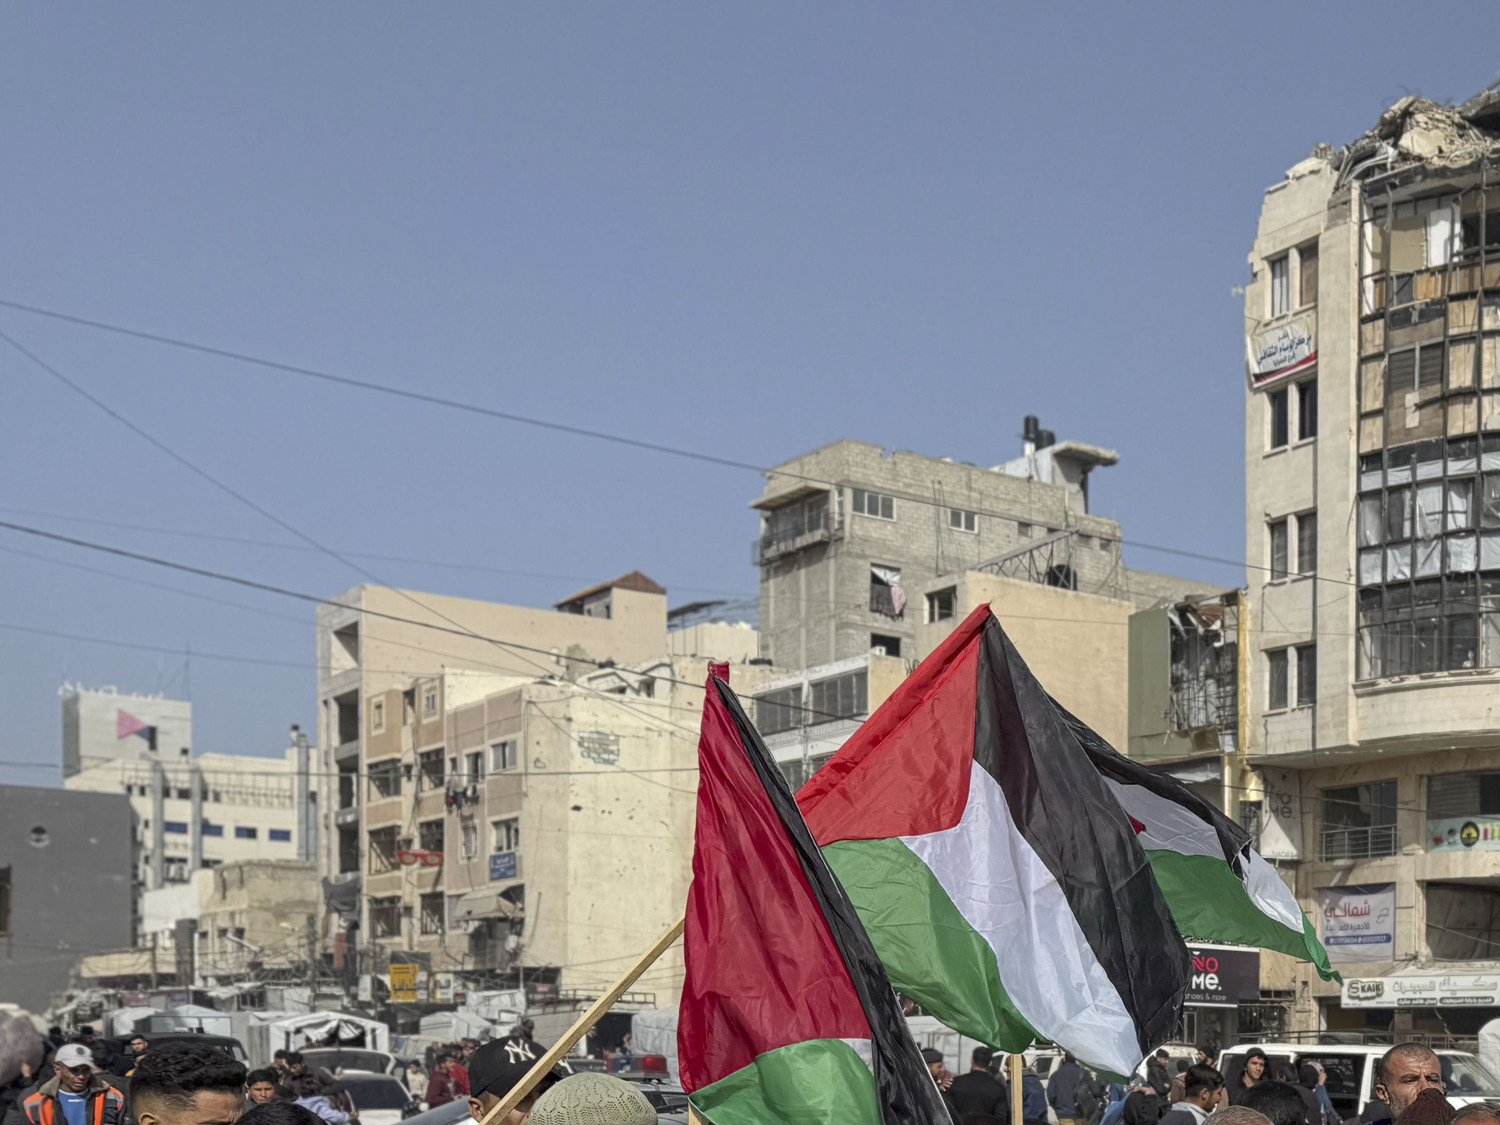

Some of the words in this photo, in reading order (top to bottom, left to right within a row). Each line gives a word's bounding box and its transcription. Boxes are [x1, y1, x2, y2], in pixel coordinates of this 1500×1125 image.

[1324, 898, 1370, 922] شمالي
[1348, 980, 1384, 995] SKAIK
[504, 1038, 536, 1064] NY
